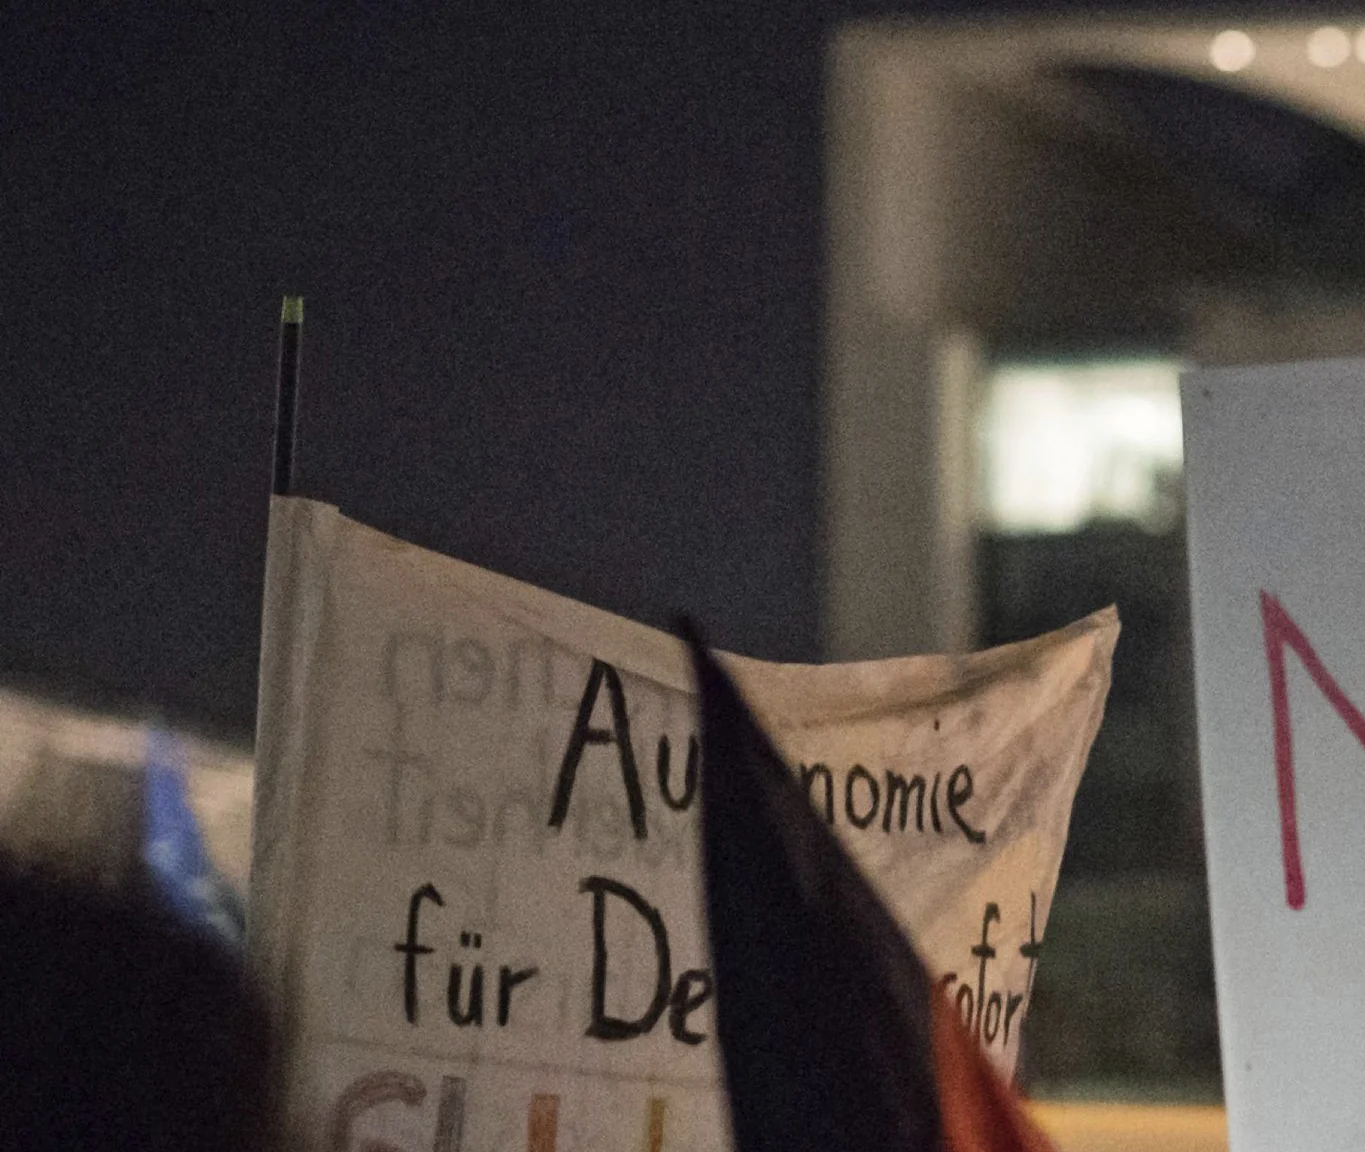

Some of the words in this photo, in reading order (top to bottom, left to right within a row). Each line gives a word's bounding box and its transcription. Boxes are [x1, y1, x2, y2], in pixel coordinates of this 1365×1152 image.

[548, 659, 987, 843] Aunomie
[394, 882, 539, 1029] für
[578, 875, 713, 1047] De
